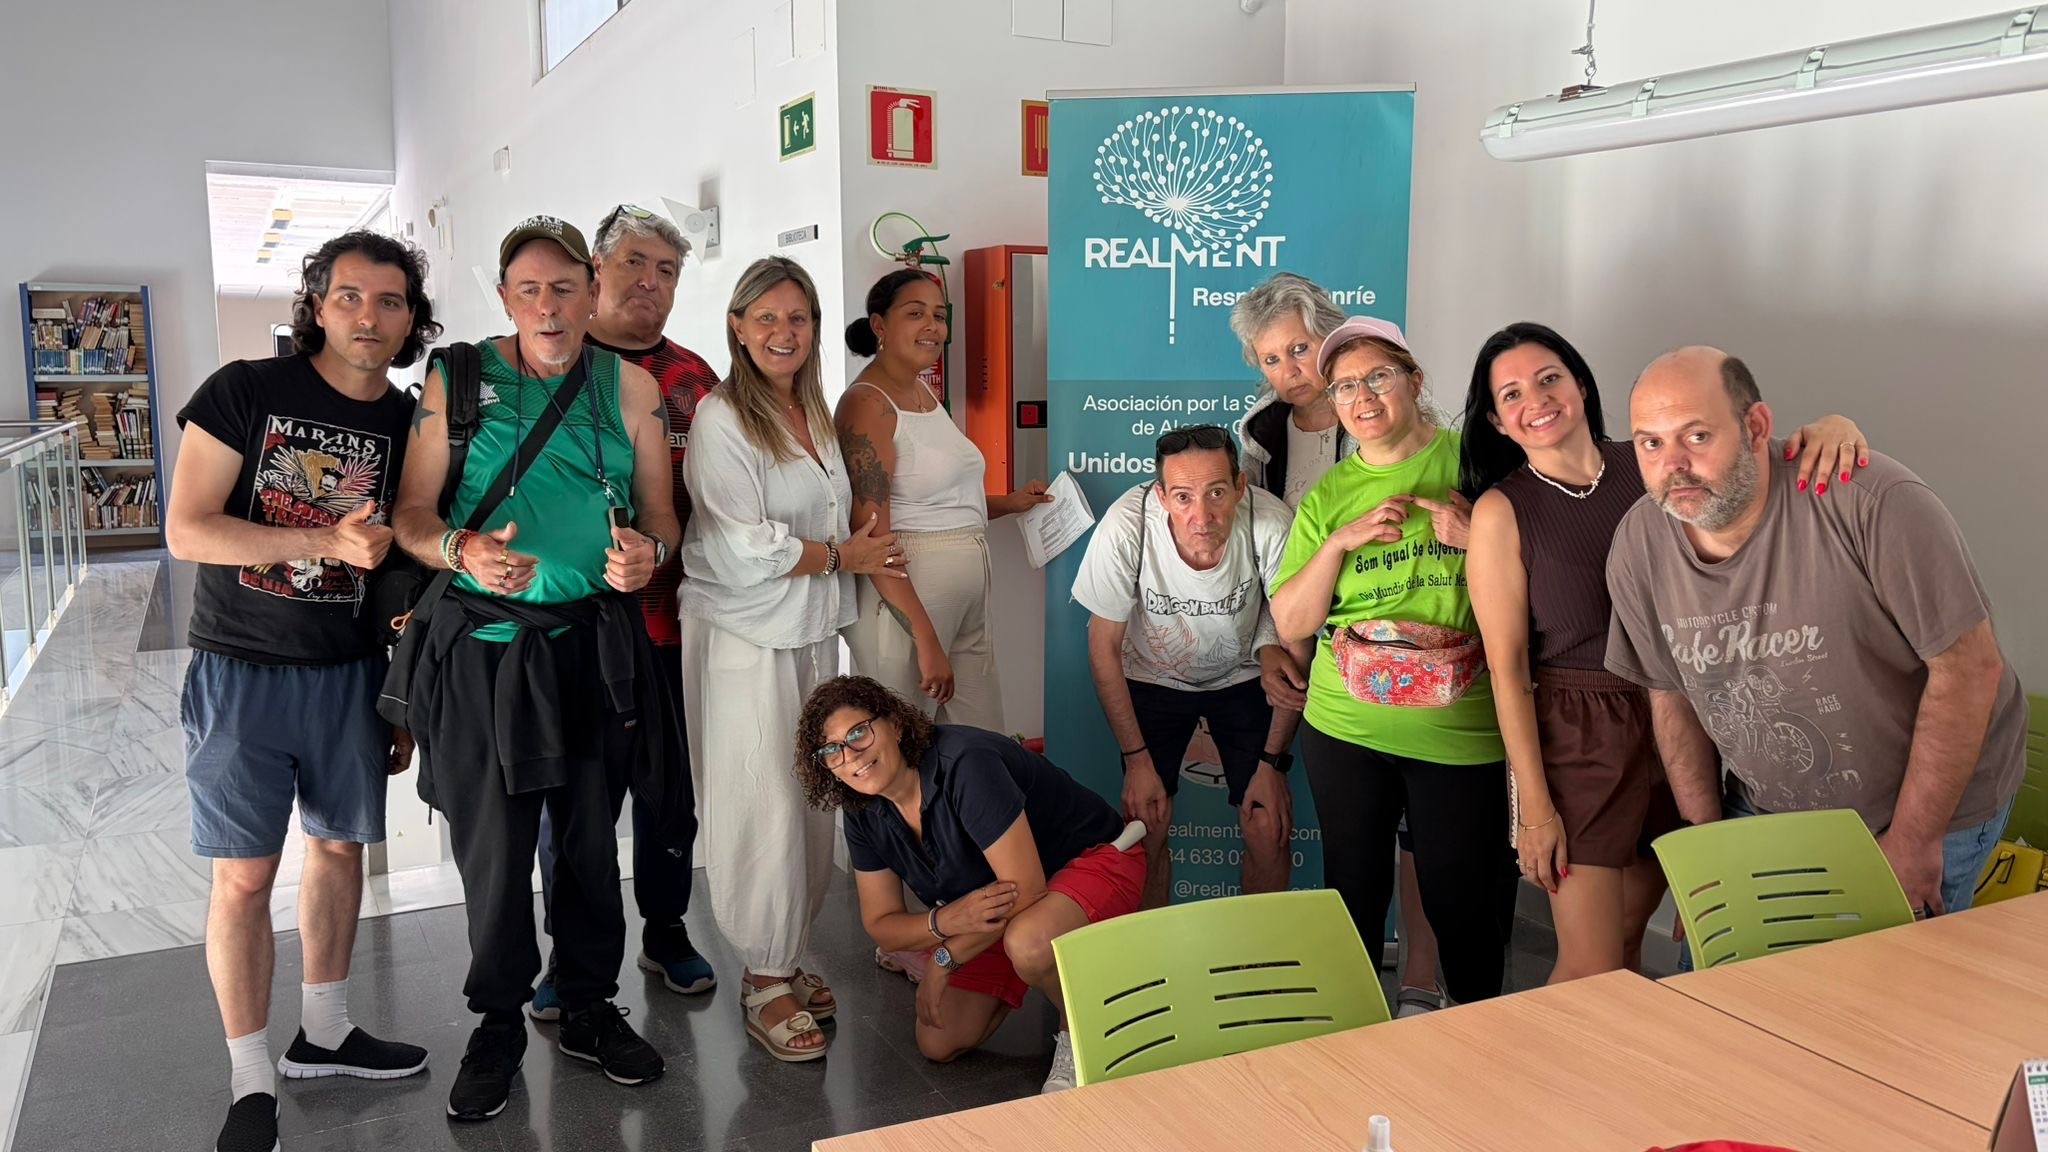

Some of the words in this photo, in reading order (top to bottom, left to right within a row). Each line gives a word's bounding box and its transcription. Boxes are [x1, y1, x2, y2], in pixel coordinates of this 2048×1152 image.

[1085, 233, 1287, 268] REALMENT
[1083, 394, 1182, 412] Asociación
[1187, 399, 1218, 415] por
[1223, 394, 1240, 411] la
[270, 416, 376, 455] MARINS
[1132, 419, 1155, 435] de
[1068, 452, 1157, 474] Unidos
[1355, 554, 1378, 574] Som
[1383, 541, 1410, 571] igual
[1412, 538, 1424, 557] de
[1416, 574, 1425, 587] la
[1428, 573, 1452, 587] Salut
[1146, 588, 1200, 616] DRAGON
[1200, 595, 1231, 616] BALL
[1676, 609, 1739, 630] MOTORCYCLE
[1742, 602, 1778, 619] CUSTOM
[1718, 620, 1825, 664] Racer
[1806, 651, 1829, 663] Street
[1815, 694, 1838, 707] RACE
[1818, 702, 1842, 716] HARD
[1190, 848, 1224, 865] 633
